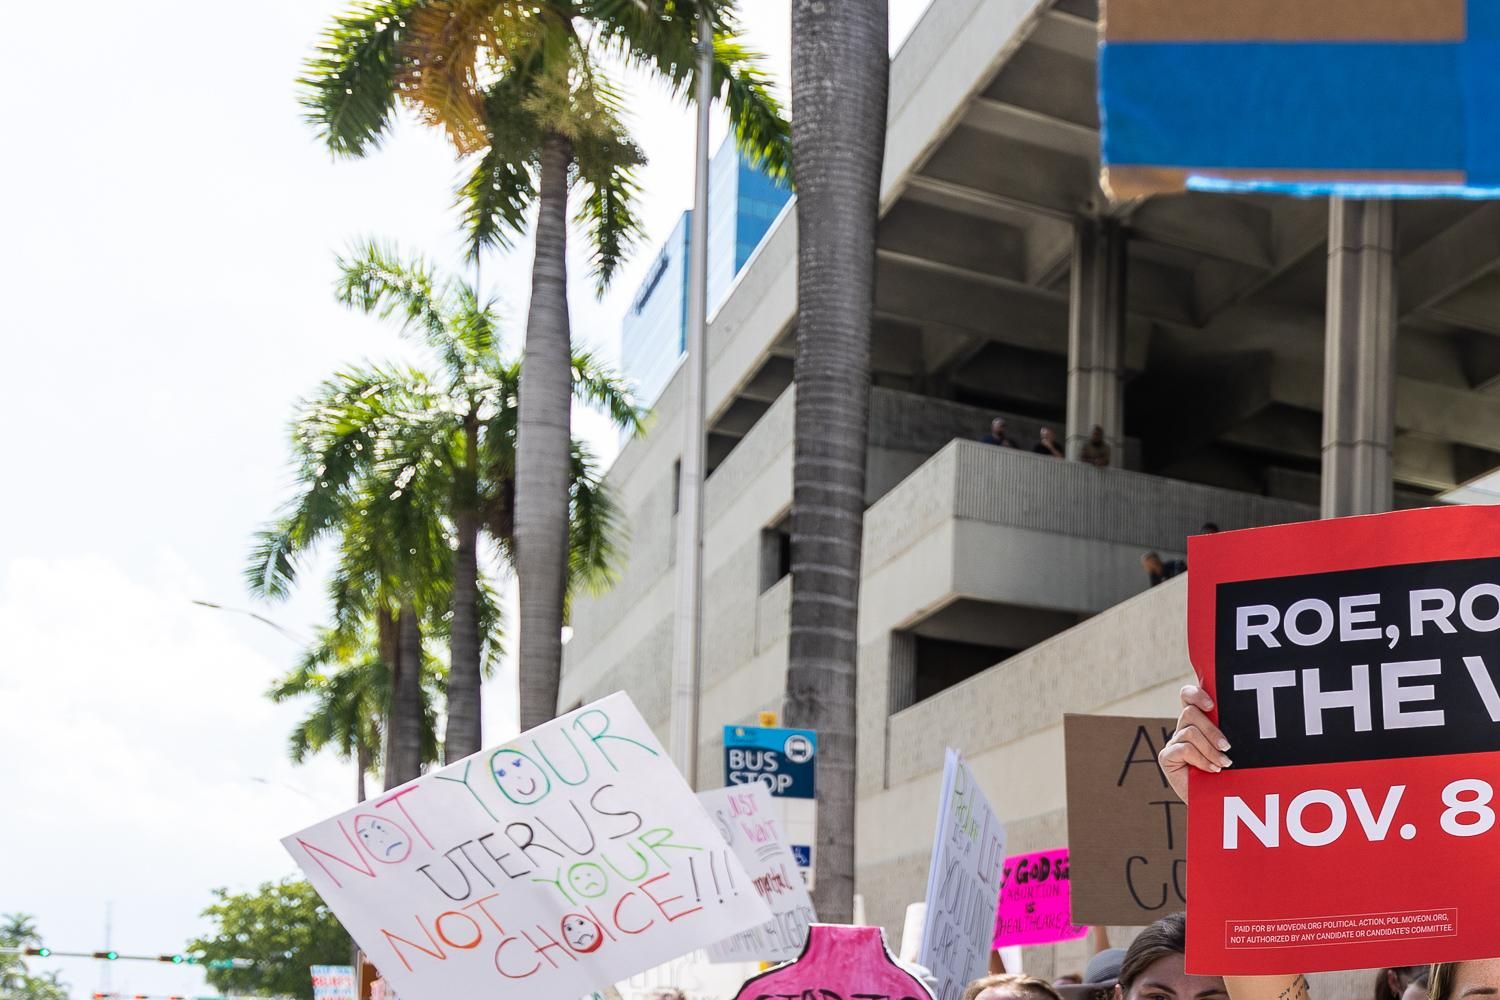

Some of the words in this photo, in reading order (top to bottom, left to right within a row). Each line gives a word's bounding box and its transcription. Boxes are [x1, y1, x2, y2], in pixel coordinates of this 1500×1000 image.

[1236, 592, 1399, 649] ROE,
[1233, 658, 1445, 739] THE
[729, 749, 779, 772] BUS
[296, 784, 436, 888] NOT
[433, 709, 660, 823] YOUR
[1222, 784, 1417, 850] NOV.
[416, 783, 643, 901] UTERUS
[381, 892, 506, 973] NOT
[531, 827, 703, 906] YOUR
[1234, 924, 1250, 933] PAID
[1251, 923, 1265, 932] FOR
[1266, 923, 1276, 932] BY
[1277, 921, 1322, 931] MOVEON.ORG
[1323, 919, 1358, 929] POLITICAL
[1359, 917, 1386, 927] ACTION,
[1387, 913, 1449, 924] POL.MOVEON.ORG,
[1231, 935, 1246, 944] NOT
[1247, 933, 1290, 943] AUTHORIZED
[1291, 932, 1300, 942] BY
[1301, 932, 1315, 941] ANY
[1316, 930, 1354, 940] CANDIDATE
[1355, 929, 1365, 938] OR
[1366, 926, 1410, 937] CANDIDATE'S
[1411, 923, 1454, 934] COMMITTEE.
